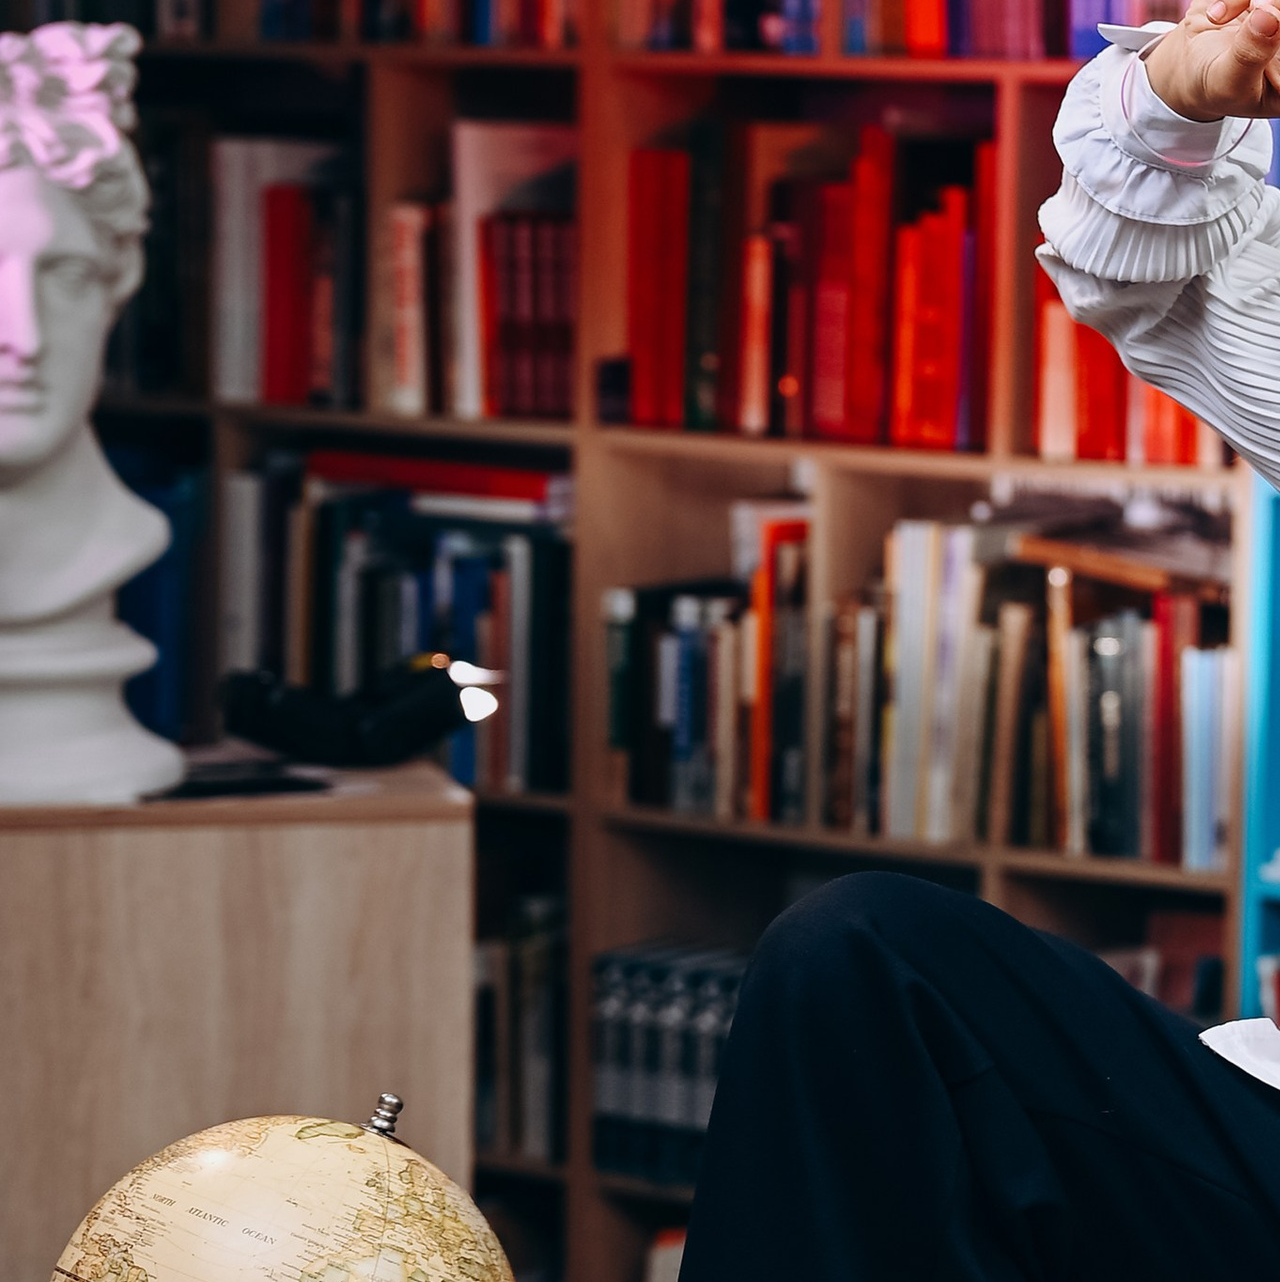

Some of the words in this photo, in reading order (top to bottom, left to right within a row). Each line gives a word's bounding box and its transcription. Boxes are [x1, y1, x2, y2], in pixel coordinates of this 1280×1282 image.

[151, 1193, 176, 1207] NORTH
[186, 1206, 229, 1228] ATLANTIC
[241, 1227, 277, 1246] OCEAN
